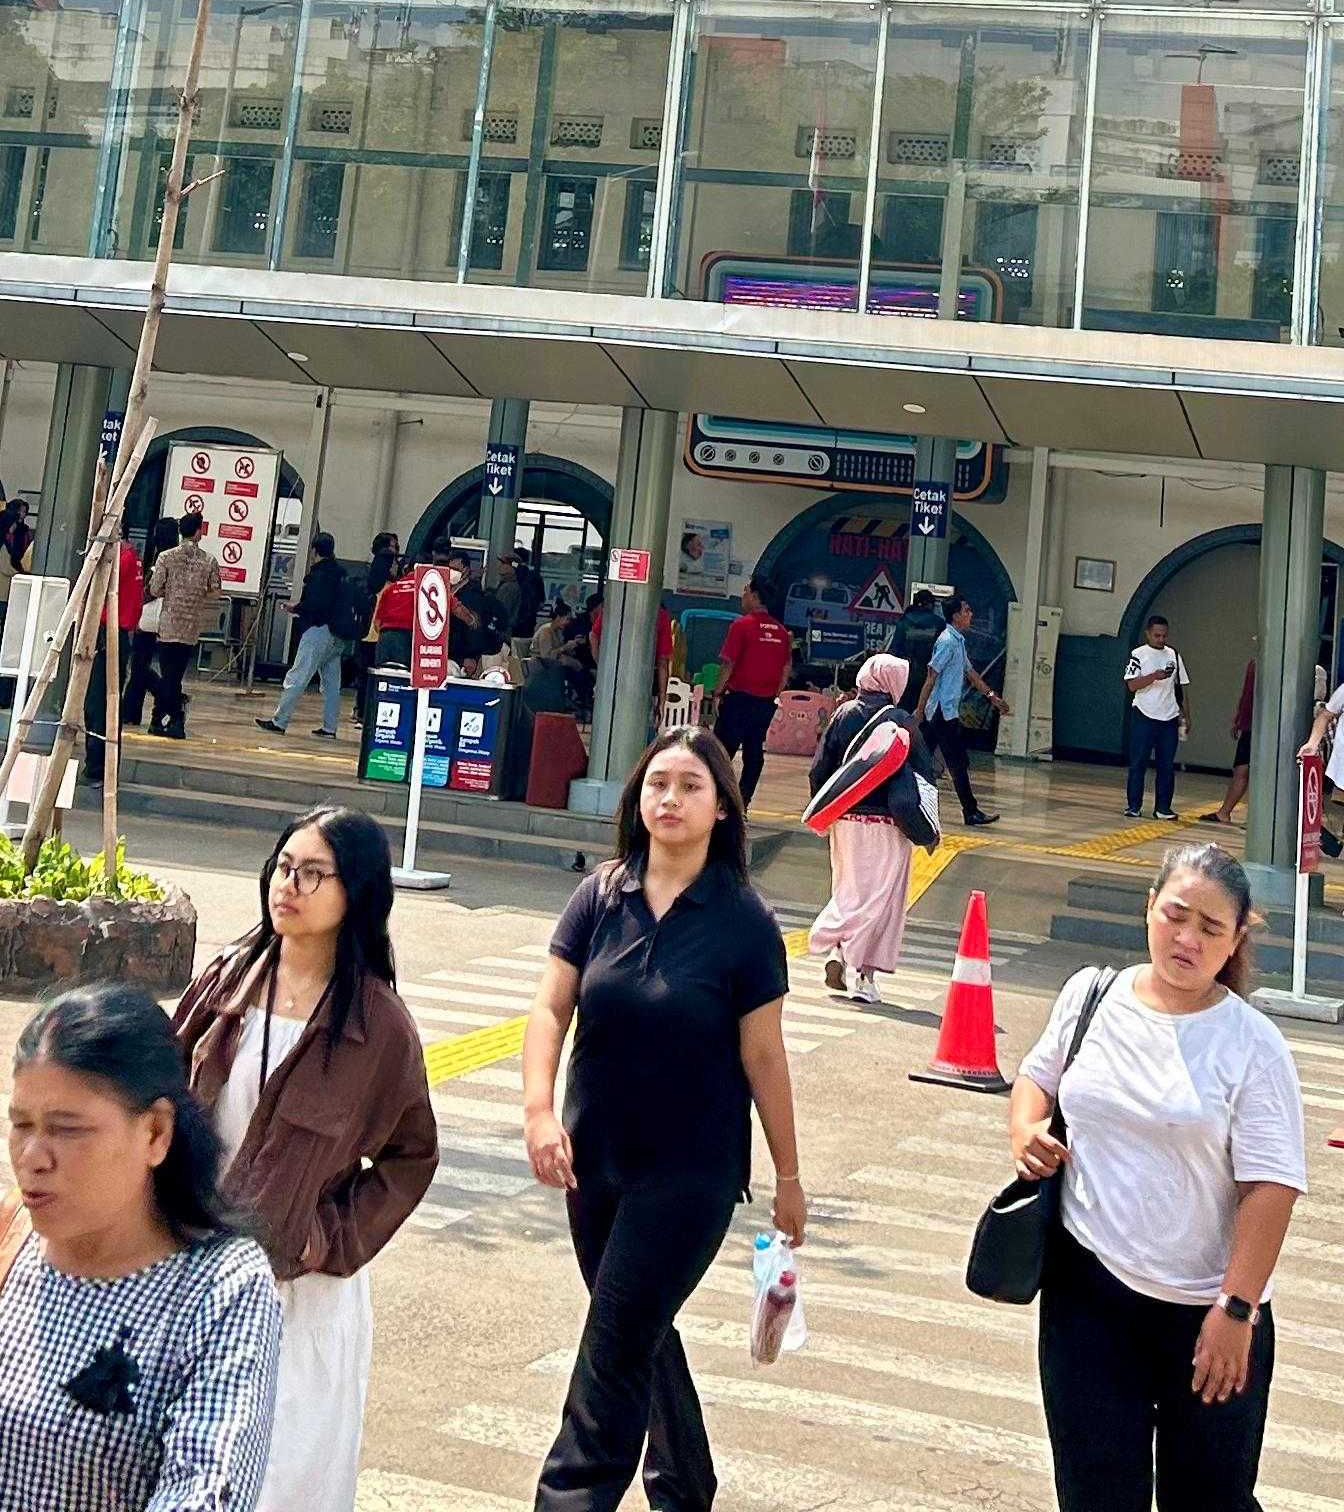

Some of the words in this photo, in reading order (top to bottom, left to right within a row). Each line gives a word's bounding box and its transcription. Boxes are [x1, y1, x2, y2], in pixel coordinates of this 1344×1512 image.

[103, 419, 121, 430] tak
[913, 488, 946, 502] Cetak
[914, 500, 943, 515] Tiket
